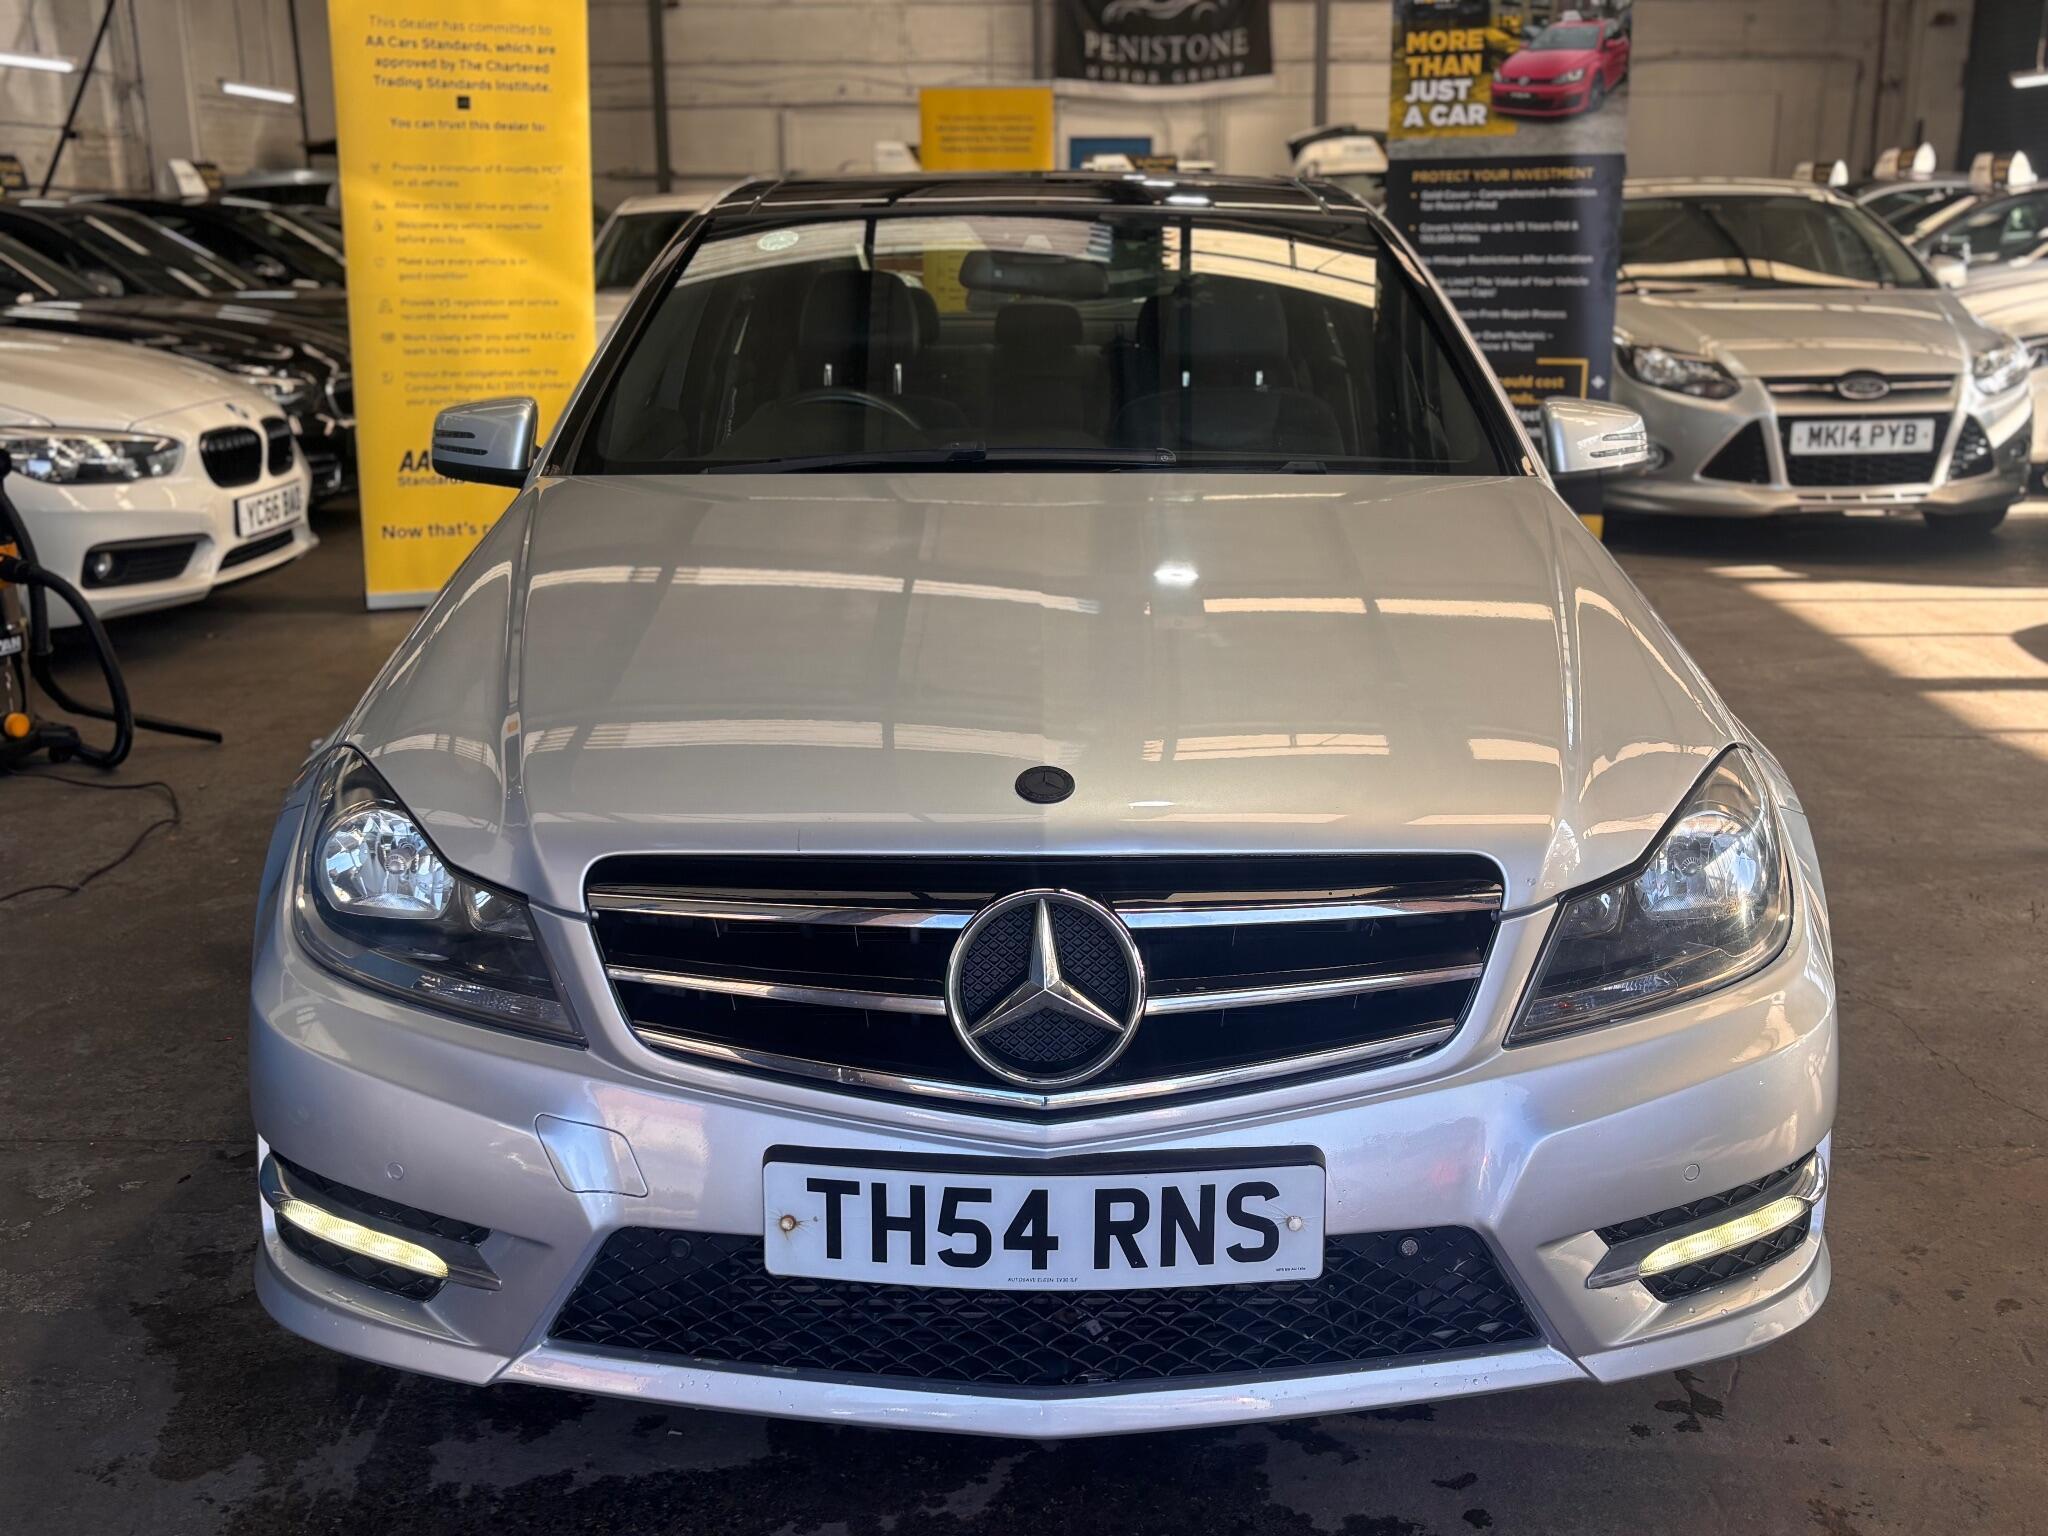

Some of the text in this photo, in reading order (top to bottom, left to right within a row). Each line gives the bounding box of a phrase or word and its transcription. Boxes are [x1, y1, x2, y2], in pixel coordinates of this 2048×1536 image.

[369, 14, 552, 35] This dealer has committed to
[365, 35, 556, 54] AA Cars Standards, which are
[1084, 27, 1249, 64] PENISTONE
[1406, 27, 1485, 53] MORE
[374, 57, 549, 74] approved by The Chartered
[1405, 53, 1482, 78] THAN
[373, 75, 423, 90] Trading
[426, 77, 492, 91] Standards
[1404, 78, 1473, 102] JUST
[390, 117, 547, 132] You can trust this dealer to:
[1403, 103, 1487, 128] A CAR
[1411, 167, 1595, 183] PROTECT YOUR INVESTMENT
[1807, 423, 1917, 448] MK14 PYB
[399, 450, 430, 472] AA
[382, 525, 422, 539] Now
[428, 522, 477, 537] that's
[806, 1177, 1281, 1270] TH54 RNS
